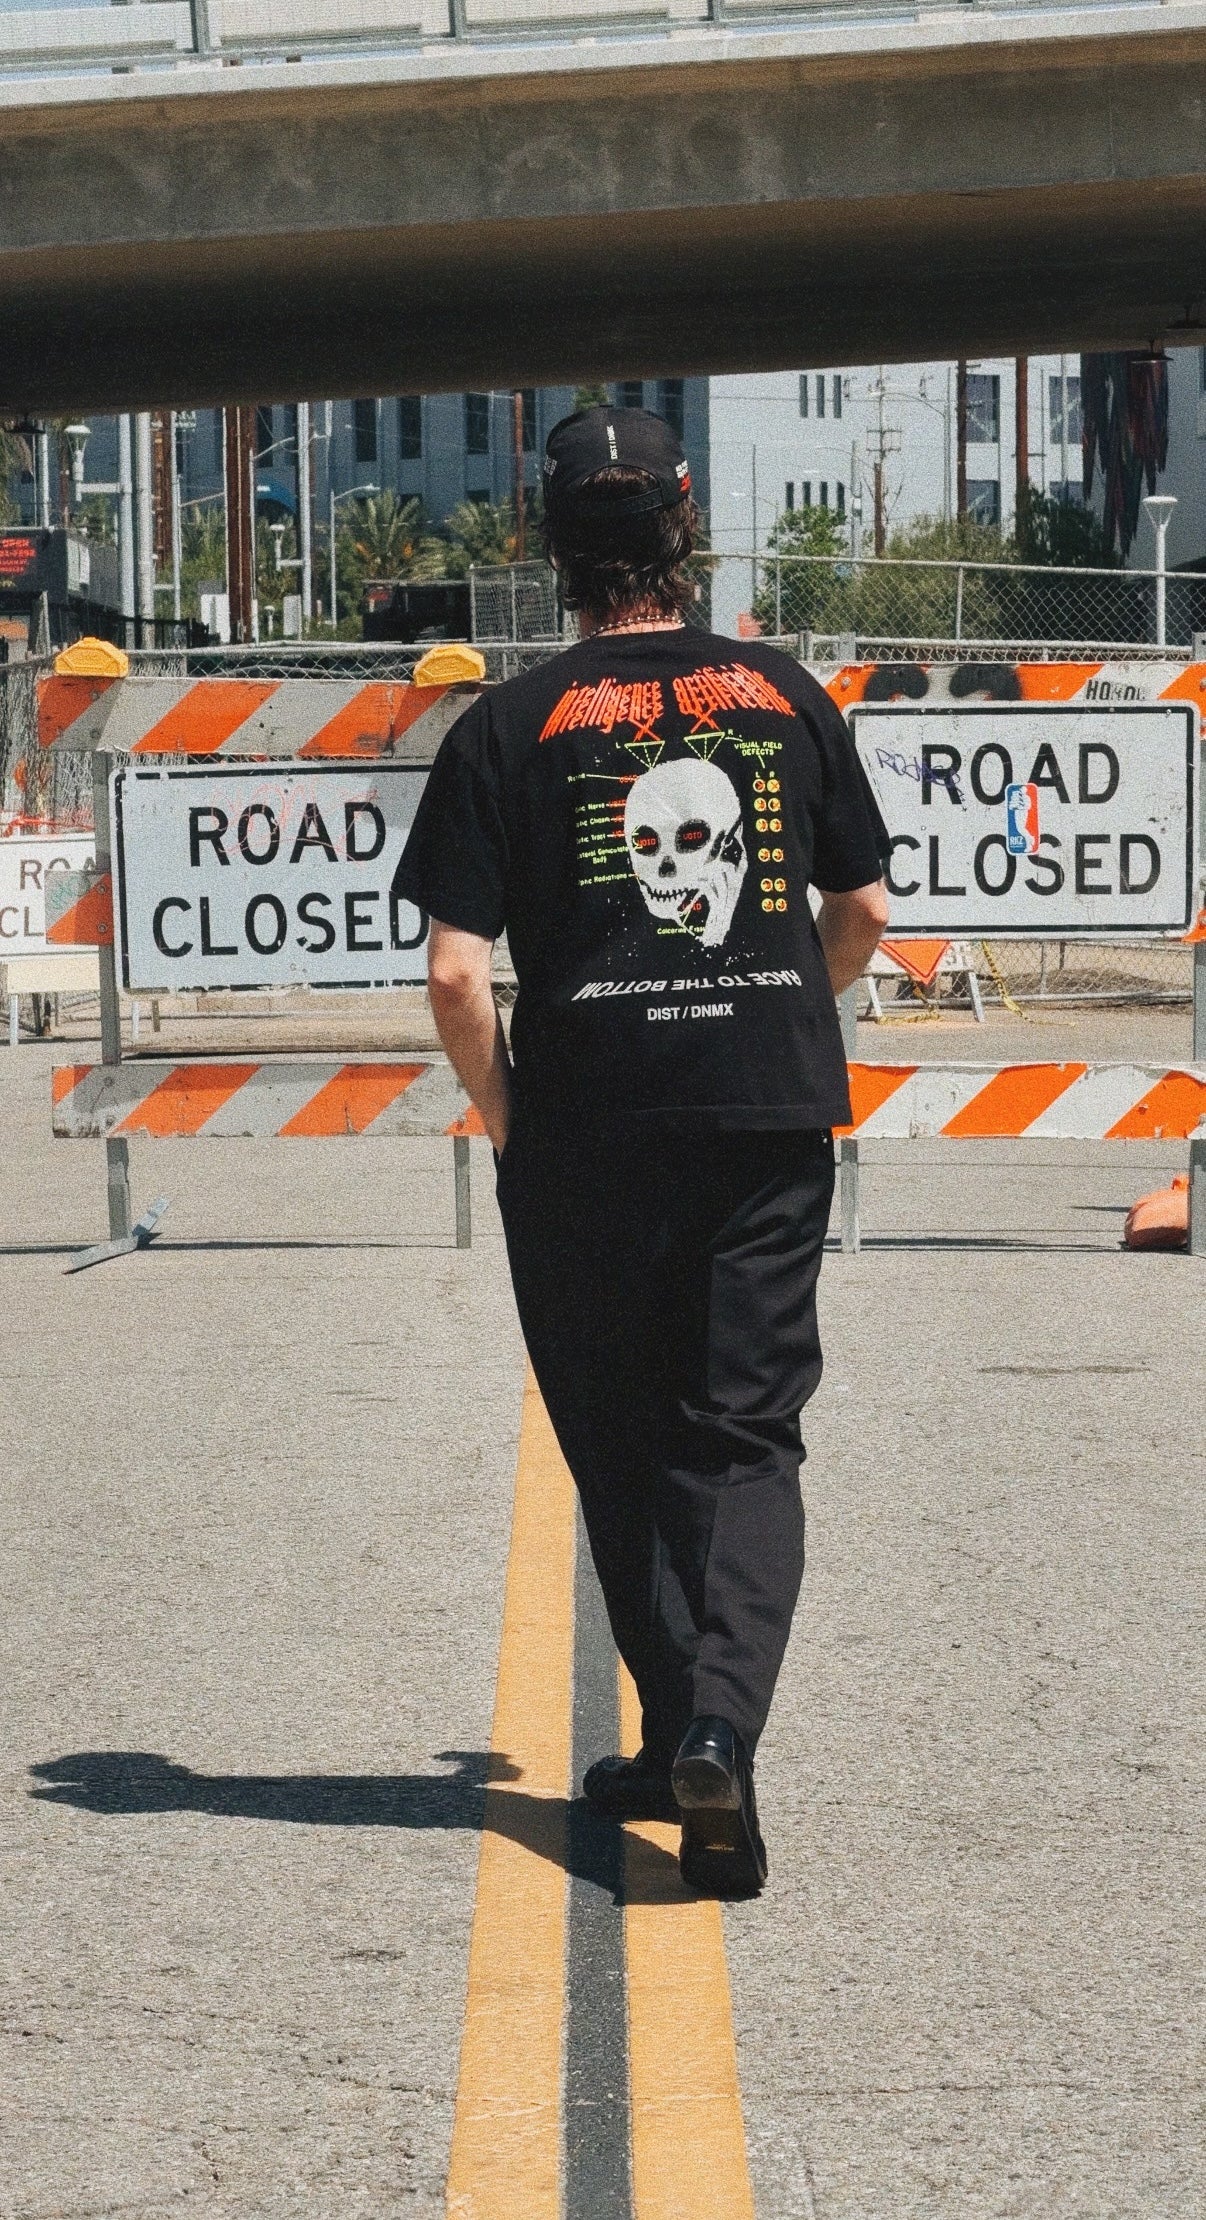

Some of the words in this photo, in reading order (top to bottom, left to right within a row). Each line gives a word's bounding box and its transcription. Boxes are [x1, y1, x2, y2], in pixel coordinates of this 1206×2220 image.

[734, 741, 760, 750] VISUAL
[762, 741, 783, 750] FIELD
[741, 748, 775, 756] DEFECTS
[921, 743, 1120, 805] ROAD
[188, 801, 386, 867] ROAD
[882, 833, 1161, 897] CLOSED
[152, 890, 430, 958] CLOSED
[671, 978, 714, 991] THE
[717, 974, 751, 987] TO
[747, 969, 802, 986] RACE
[571, 980, 667, 1001] BOTTOM
[647, 1007, 680, 1021] DIST
[682, 1006, 688, 1019] /
[690, 1003, 734, 1019] DNMX
